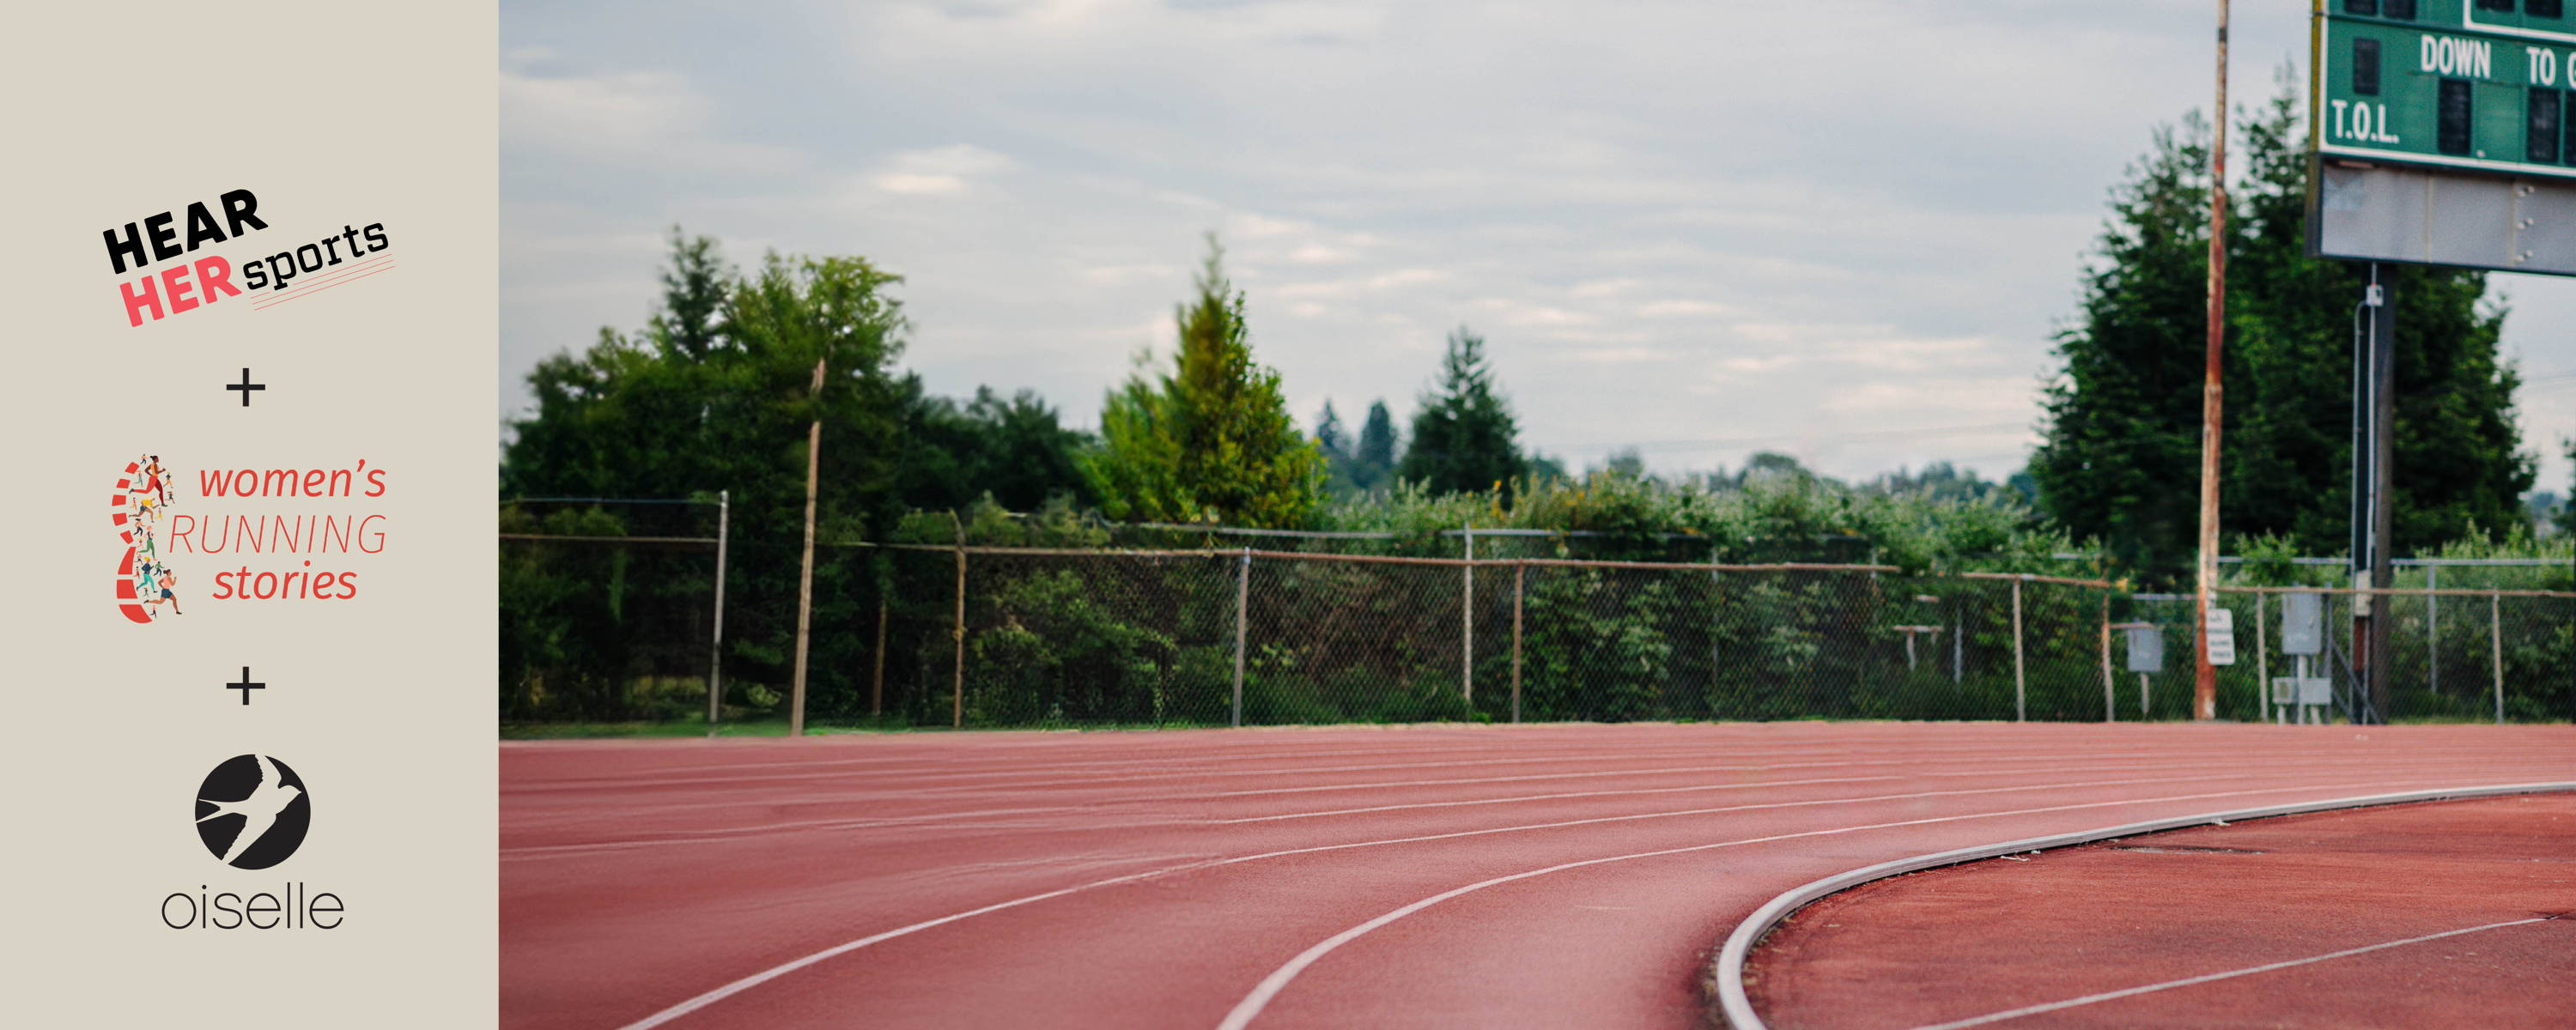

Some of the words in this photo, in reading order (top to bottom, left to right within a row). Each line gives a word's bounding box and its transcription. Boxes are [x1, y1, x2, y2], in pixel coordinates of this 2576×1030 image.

[2421, 34, 2491, 78] DOWN
[2526, 46, 2556, 86] TO
[2331, 100, 2399, 143] T.O.L.
